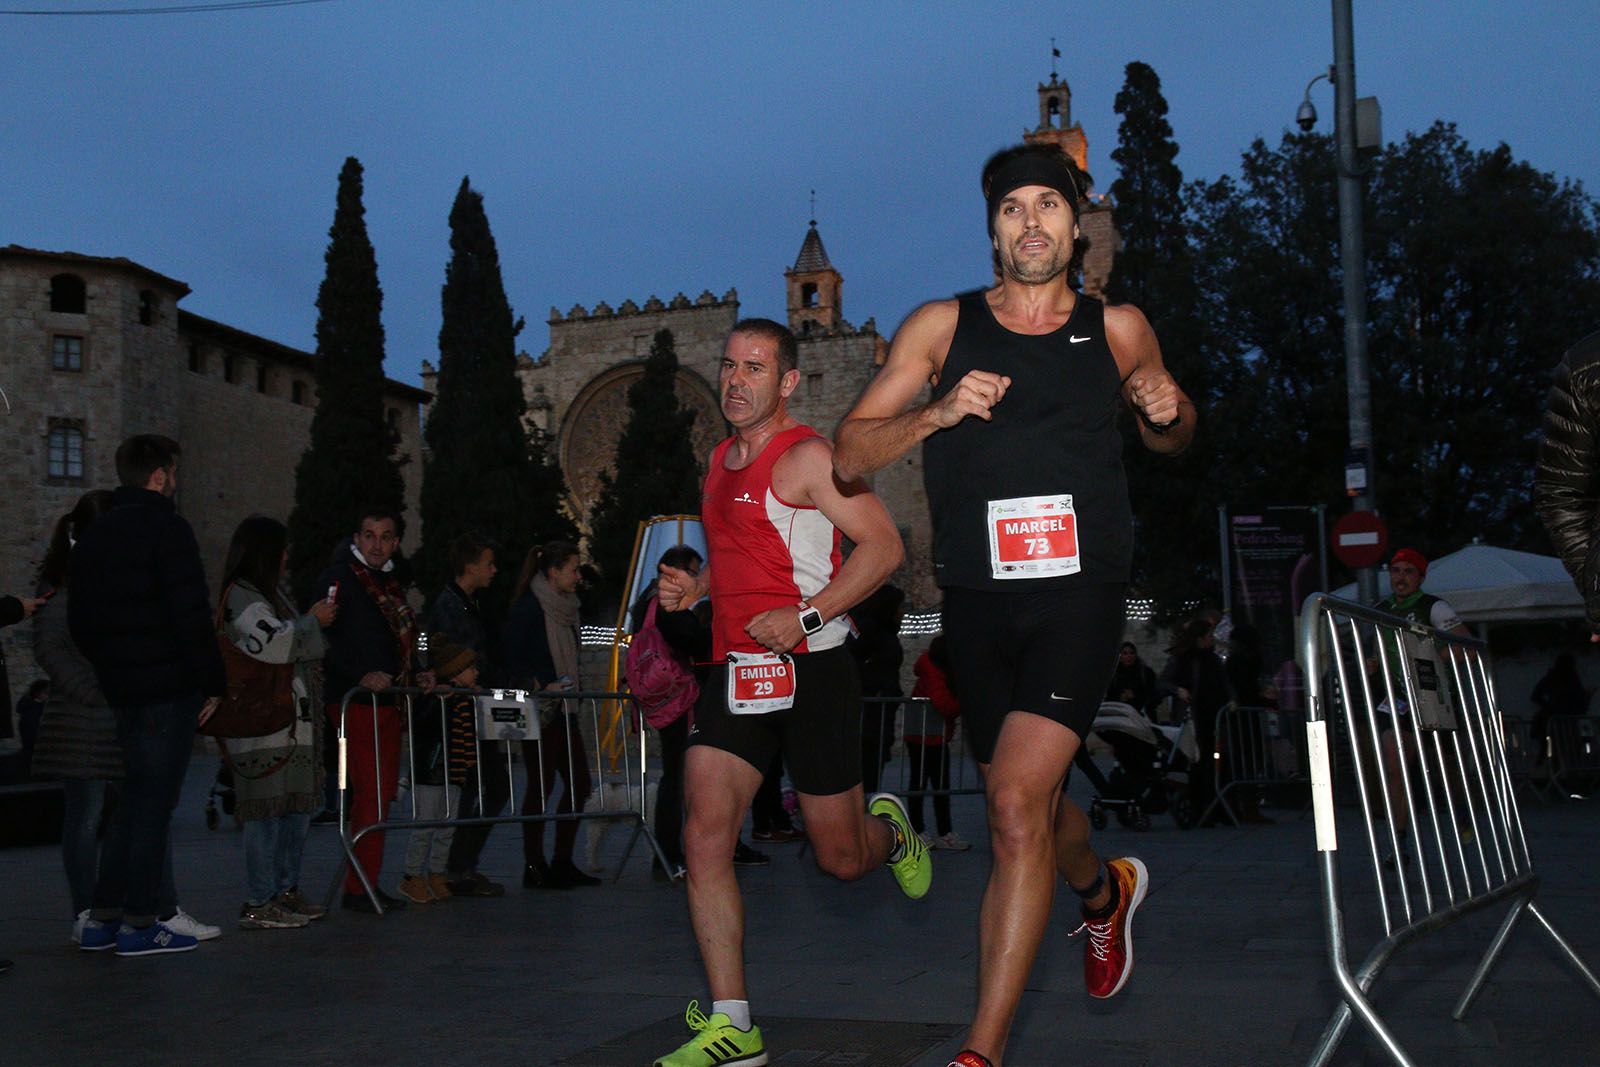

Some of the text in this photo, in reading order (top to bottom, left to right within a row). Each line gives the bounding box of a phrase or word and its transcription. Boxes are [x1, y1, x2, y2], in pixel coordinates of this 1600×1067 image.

[1005, 519, 1067, 535] MARCEL
[1024, 537, 1050, 556] 73
[740, 665, 787, 679] EMILIO
[754, 681, 774, 696] 29
